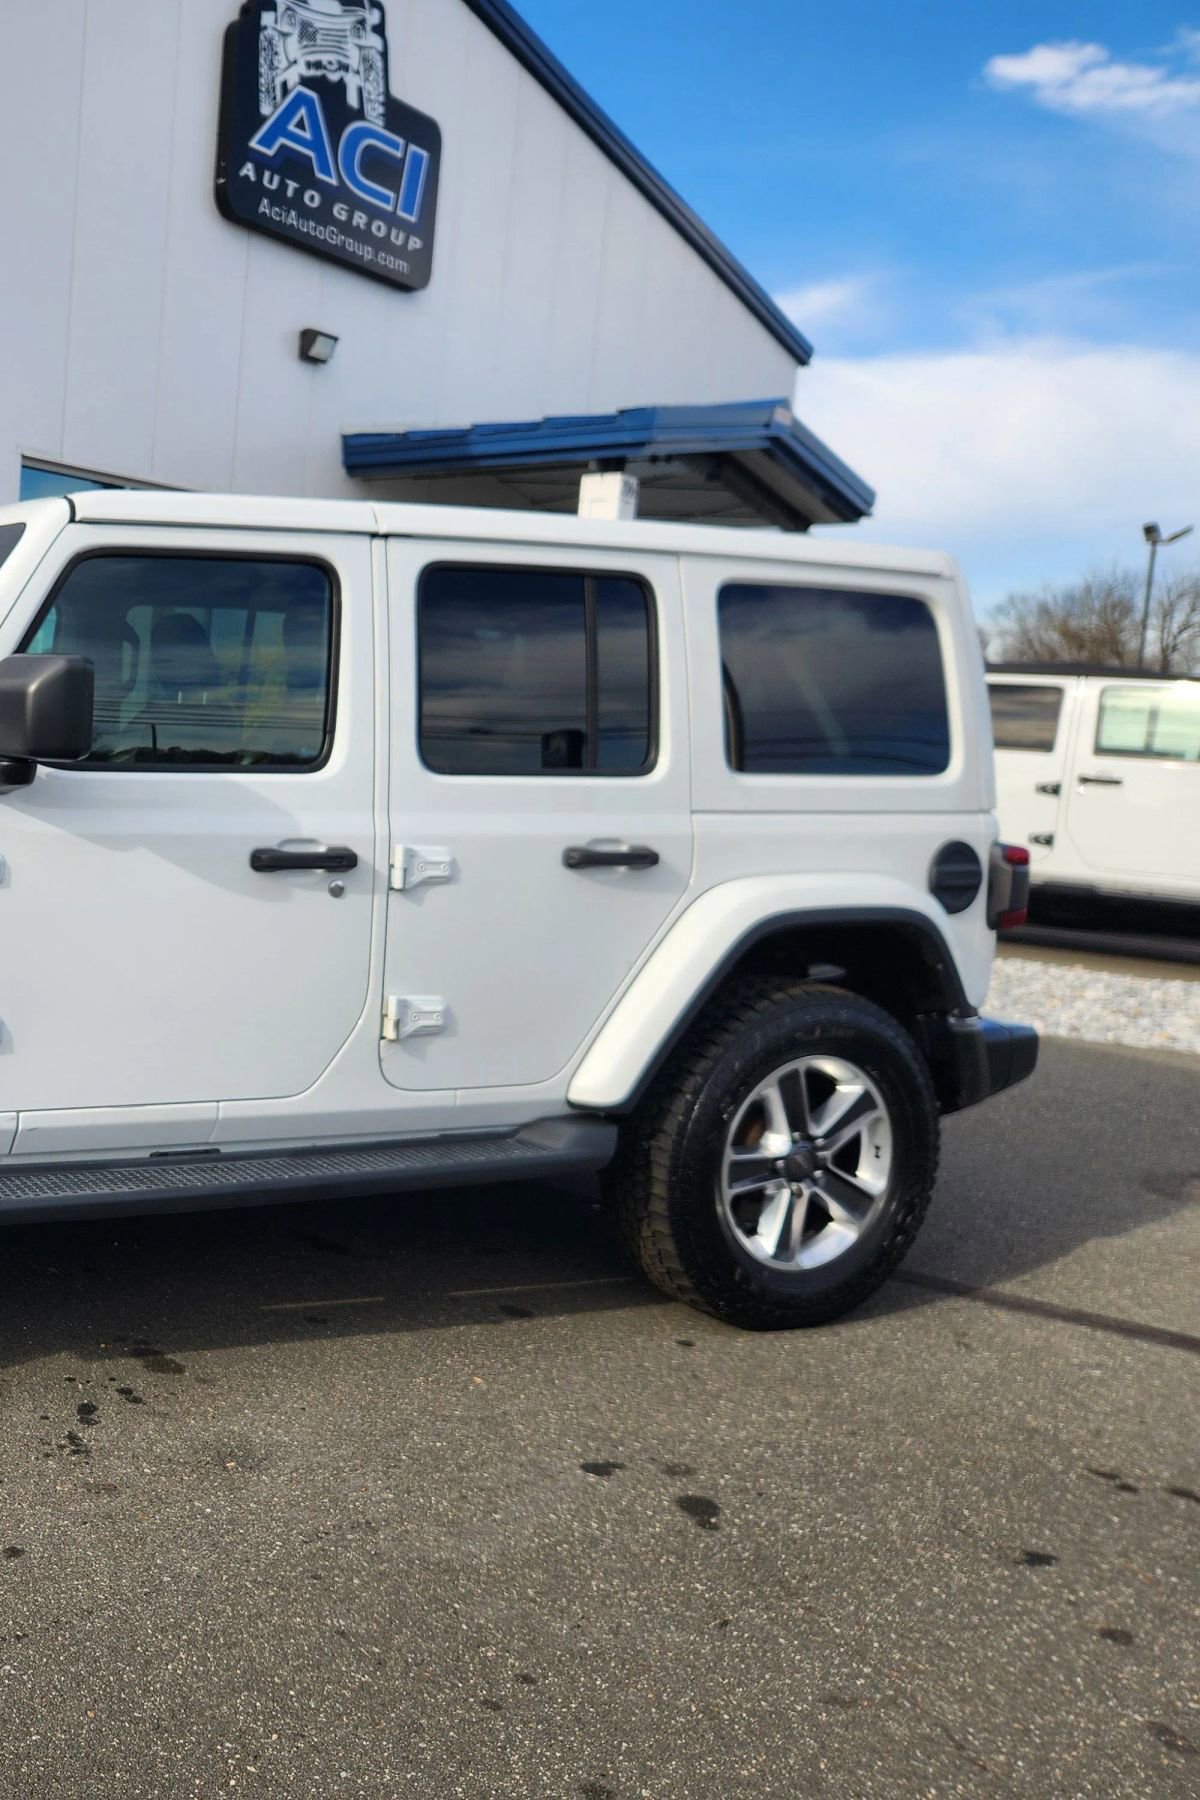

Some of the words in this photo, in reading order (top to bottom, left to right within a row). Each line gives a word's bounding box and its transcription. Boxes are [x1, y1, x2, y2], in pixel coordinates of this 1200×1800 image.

[248, 84, 430, 224] ACI
[238, 161, 322, 208] AUTO
[332, 202, 424, 251] GROUP
[257, 197, 410, 275] AciAutoGroup.com
